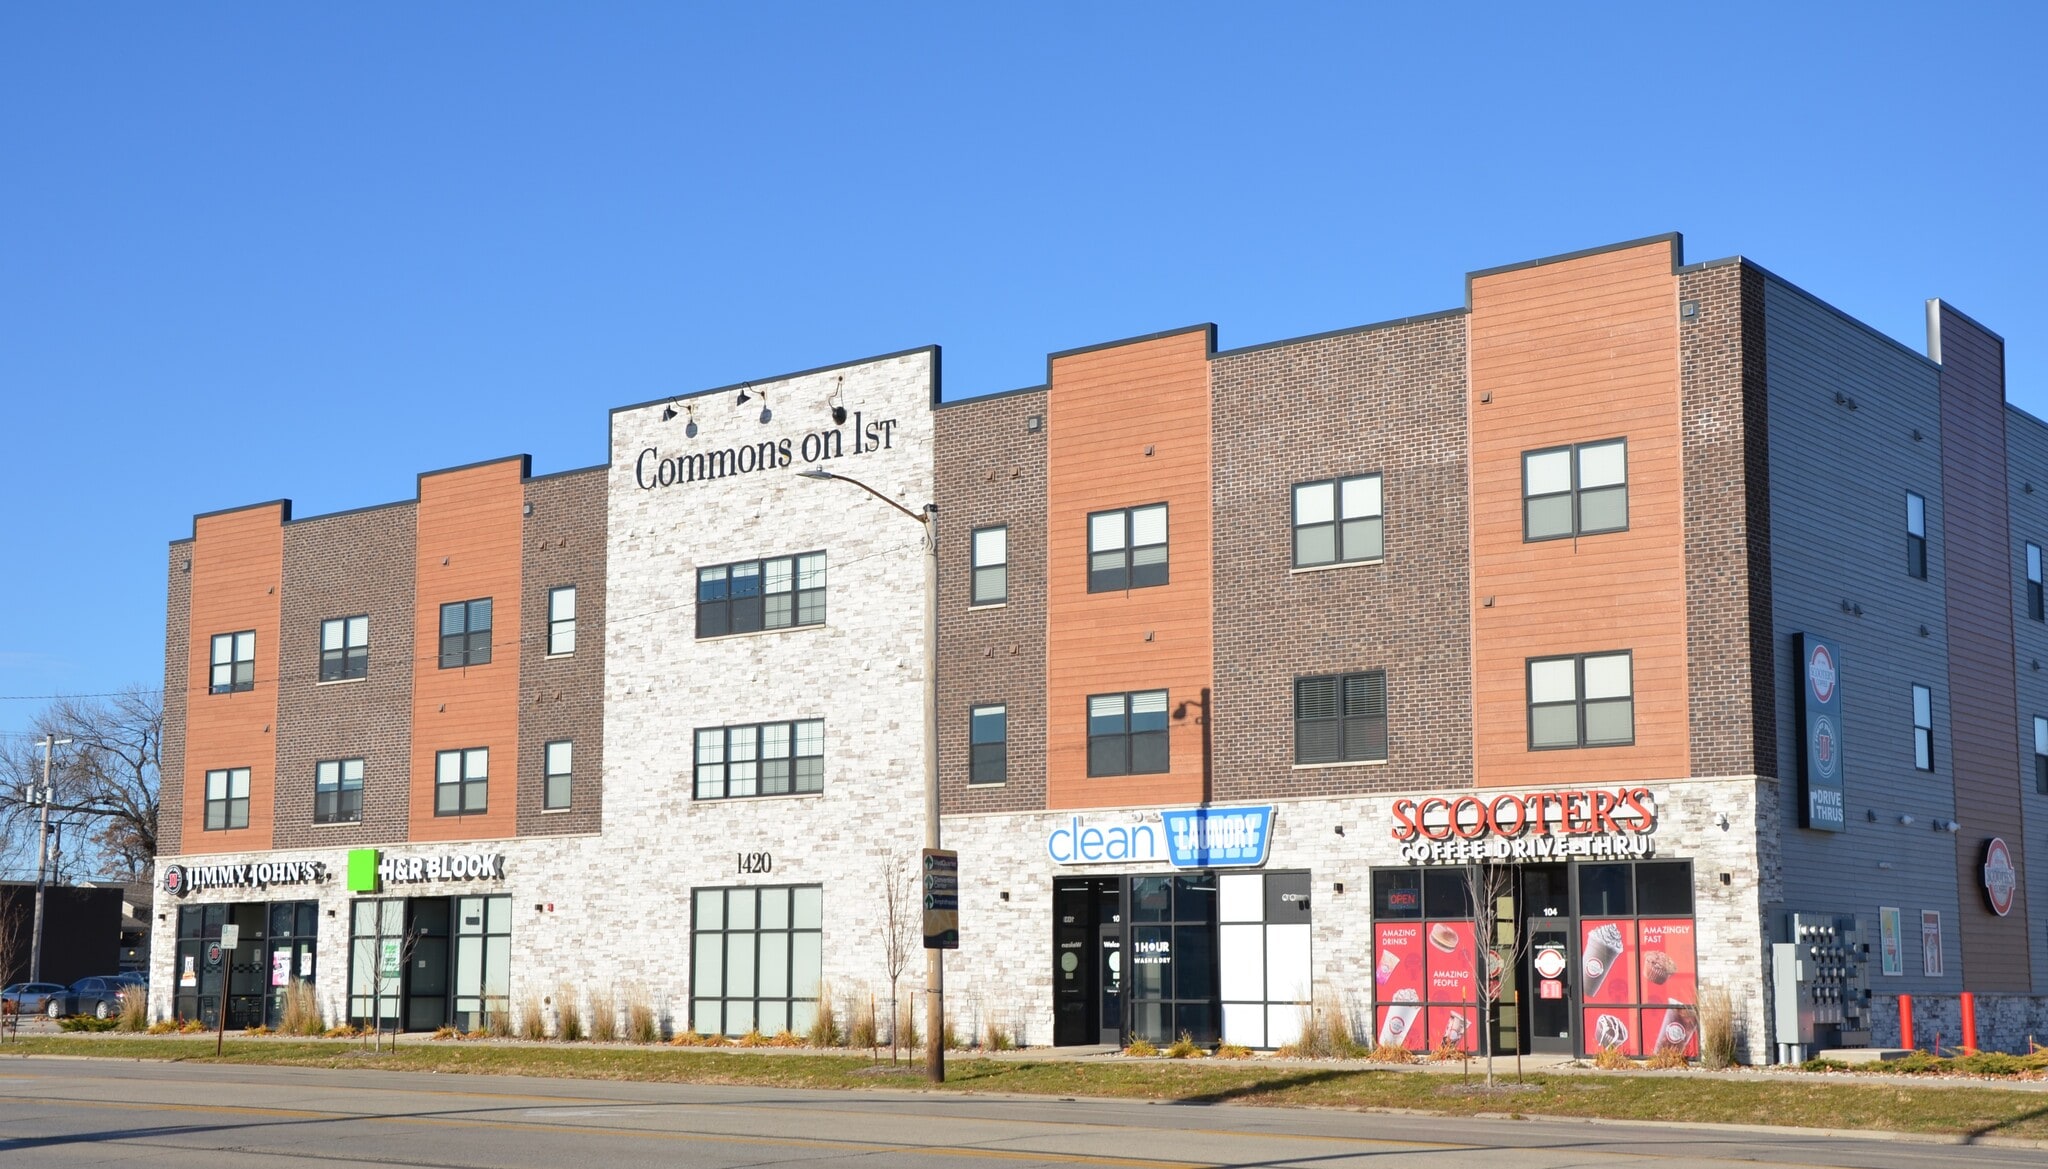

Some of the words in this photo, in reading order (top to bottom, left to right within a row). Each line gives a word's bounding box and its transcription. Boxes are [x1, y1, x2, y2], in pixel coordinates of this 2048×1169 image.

[636, 437, 792, 490] Commons
[801, 428, 844, 463] on
[1817, 789, 1841, 806] DRIVE
[1392, 787, 1652, 839] SCOOTER'S
[1816, 805, 1843, 822] THRUS
[1049, 817, 1154, 861] clean
[1178, 816, 1256, 850] LAUNDRY
[1400, 840, 1486, 862] COFFEE
[1497, 834, 1649, 859] DRIVE-THRU
[380, 857, 423, 881] H&R
[737, 852, 772, 873] 1420
[186, 864, 247, 890] JIMMY
[249, 861, 316, 887] JOHN'S
[1390, 894, 1416, 905] OPEN
[1543, 907, 1558, 917] 104
[1382, 929, 1417, 937] AMAZING
[1644, 925, 1690, 934] AMAZINGLY
[1140, 941, 1169, 953] HOUR
[1382, 938, 1408, 946] DRINKS
[1643, 935, 1662, 943] FAST
[1433, 971, 1469, 979] AMAZING
[1433, 979, 1459, 987] PEOPLE
